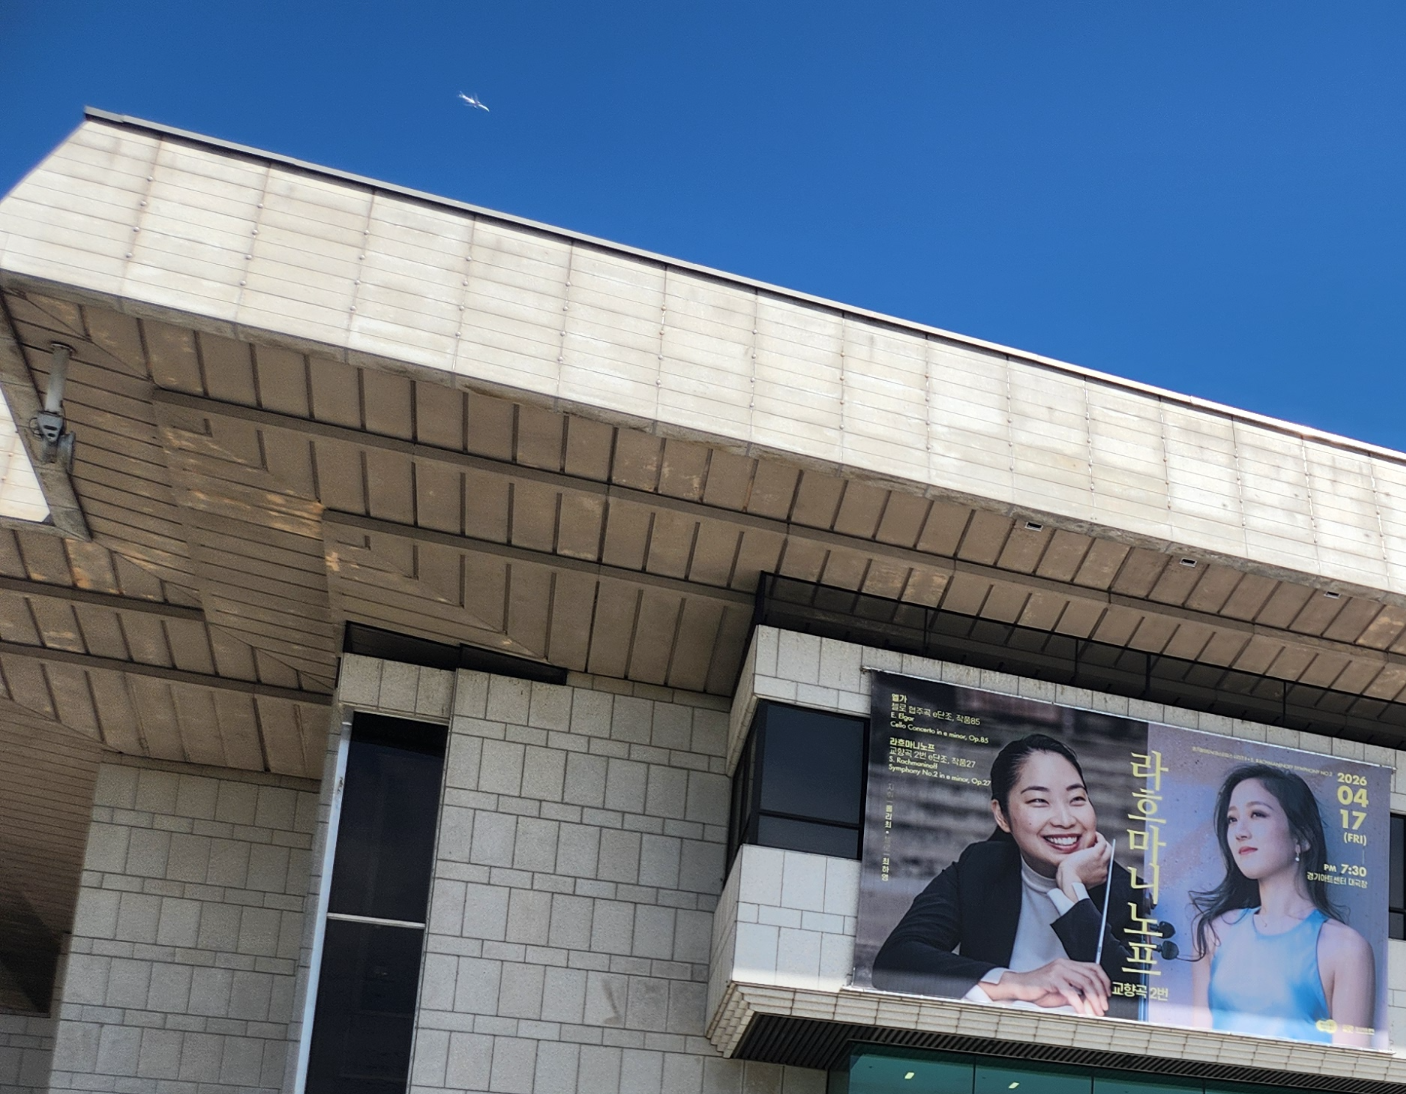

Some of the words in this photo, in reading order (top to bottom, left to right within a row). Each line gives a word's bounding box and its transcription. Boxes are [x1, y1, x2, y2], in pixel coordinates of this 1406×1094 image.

[891, 693, 908, 703] 엘가
[898, 713, 915, 722] Elgar
[908, 705, 931, 717] 협주곡
[956, 714, 981, 726] 작품85
[890, 721, 906, 730] Cello
[907, 724, 936, 735] Concerto
[936, 728, 943, 736] in
[949, 730, 968, 741] minor,
[968, 734, 989, 745] Op.85
[889, 737, 935, 753] 라흐마니노프
[888, 755, 895, 763] S.
[896, 757, 938, 770] Rachmaninoff
[889, 746, 913, 758] 교향곡
[914, 751, 927, 760] 2번
[951, 757, 976, 769] 작품27
[888, 763, 921, 776] Symphony
[921, 768, 938, 778] No.2
[939, 771, 946, 779] in
[951, 773, 971, 784] minor,
[970, 777, 992, 787] Op.27
[1337, 772, 1368, 786] 2026
[1336, 785, 1369, 808] 04
[1340, 808, 1367, 830] 17
[1343, 831, 1367, 846] (FRI)
[1122, 749, 1169, 976] 라흐마니노프
[1323, 863, 1337, 872] PM
[1341, 863, 1367, 877] 7:30
[1306, 871, 1347, 885] 경기아트센터
[1348, 877, 1368, 889] 대극장
[1112, 981, 1147, 999] 교향곡
[1150, 987, 1169, 1001] 2번
